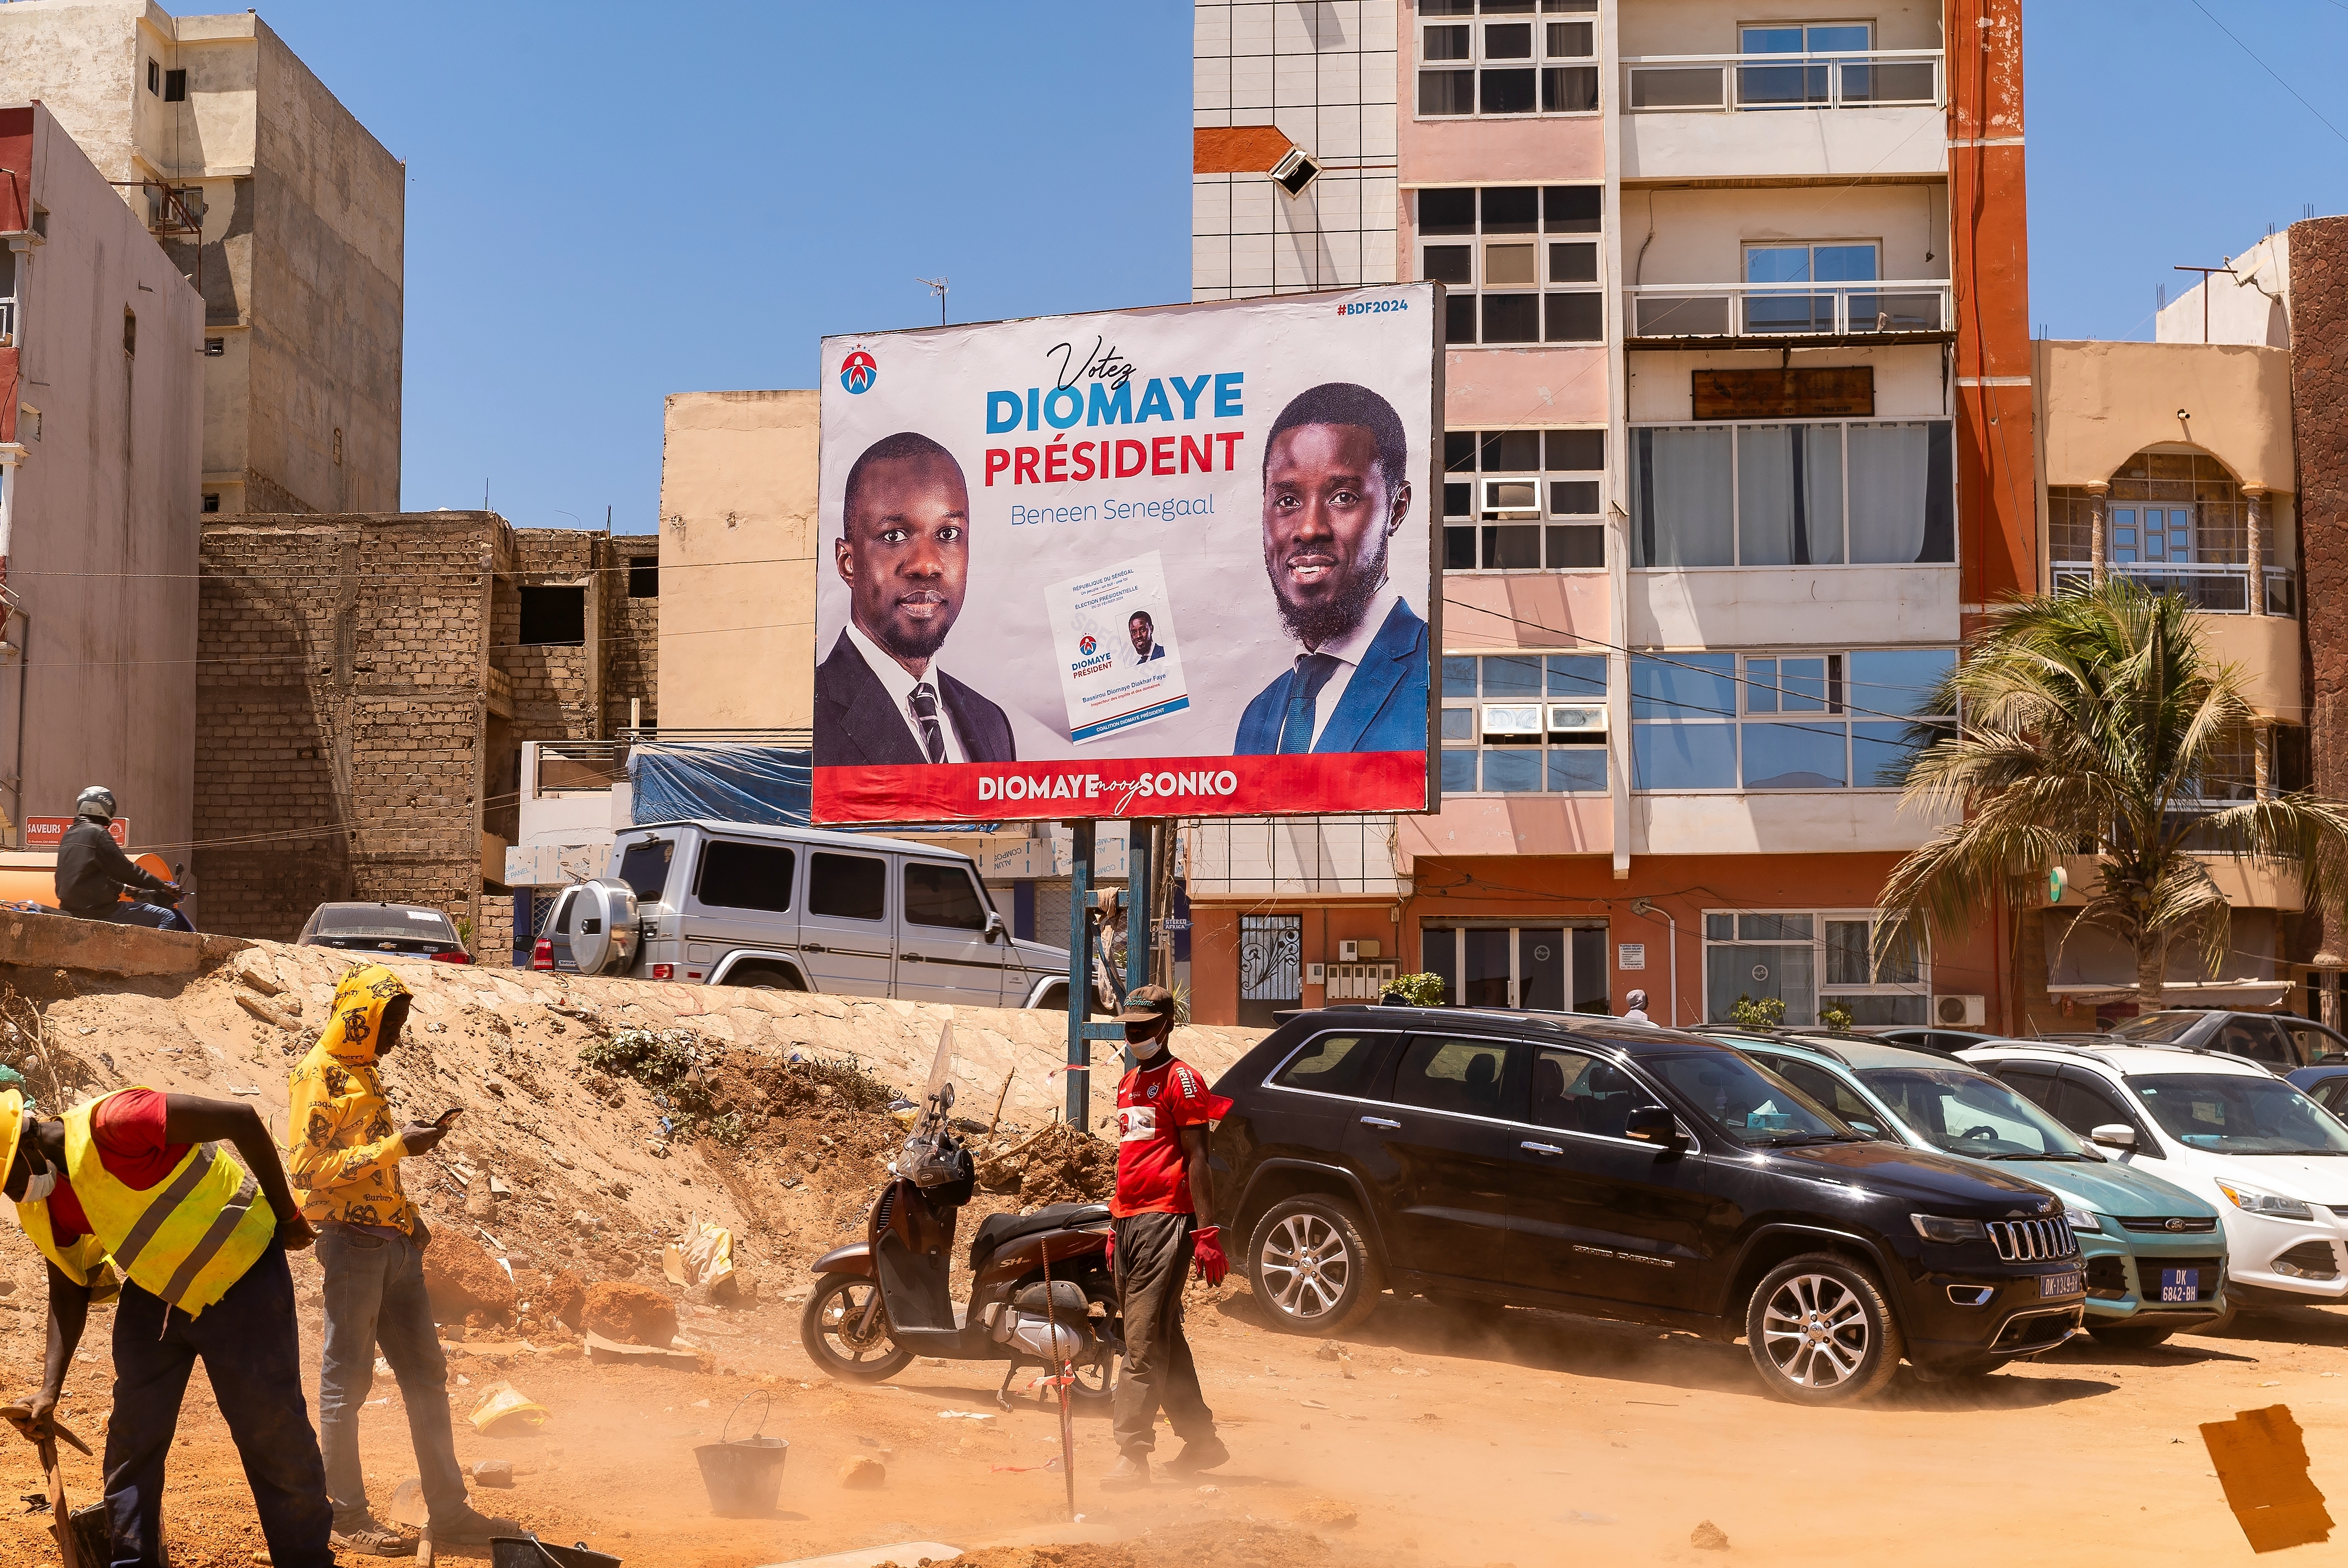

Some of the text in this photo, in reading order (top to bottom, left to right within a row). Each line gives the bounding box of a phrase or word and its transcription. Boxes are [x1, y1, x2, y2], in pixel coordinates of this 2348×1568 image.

[1337, 300, 1408, 316] #BDF2024
[1047, 335, 1136, 391] Votez
[986, 372, 1244, 434] DIOMAYE
[985, 431, 1244, 487] PRÉSIDENT
[1011, 494, 1214, 525] Beneen Senegaal
[1072, 578, 1103, 592] RÉPUBLIQUE
[1111, 569, 1134, 580] SÉNÉGAL
[1075, 585, 1139, 610] ÉLECTION PRÉSIDENTIELLE
[1071, 612, 1170, 687] SPECIMEN
[1072, 652, 1111, 671] DIOMAYE
[1073, 661, 1113, 679] PRÉSIDENT
[1082, 673, 1166, 703] Bassirou Diomaye Diakhar Faye
[1096, 708, 1165, 732] COALITION DIOMAYE PRÉSIDENT
[979, 770, 1238, 815] DIOMAYE mooy SONKO
[27, 823, 61, 834] SAVEURS
[511, 867, 530, 879] PANEL
[1131, 1116, 1151, 1131] LG
[300, 1199, 330, 1212] urberry
[2171, 1220, 2182, 1229] Ford
[1573, 1245, 1613, 1258] GRAND
[2176, 1270, 2187, 1285] DK
